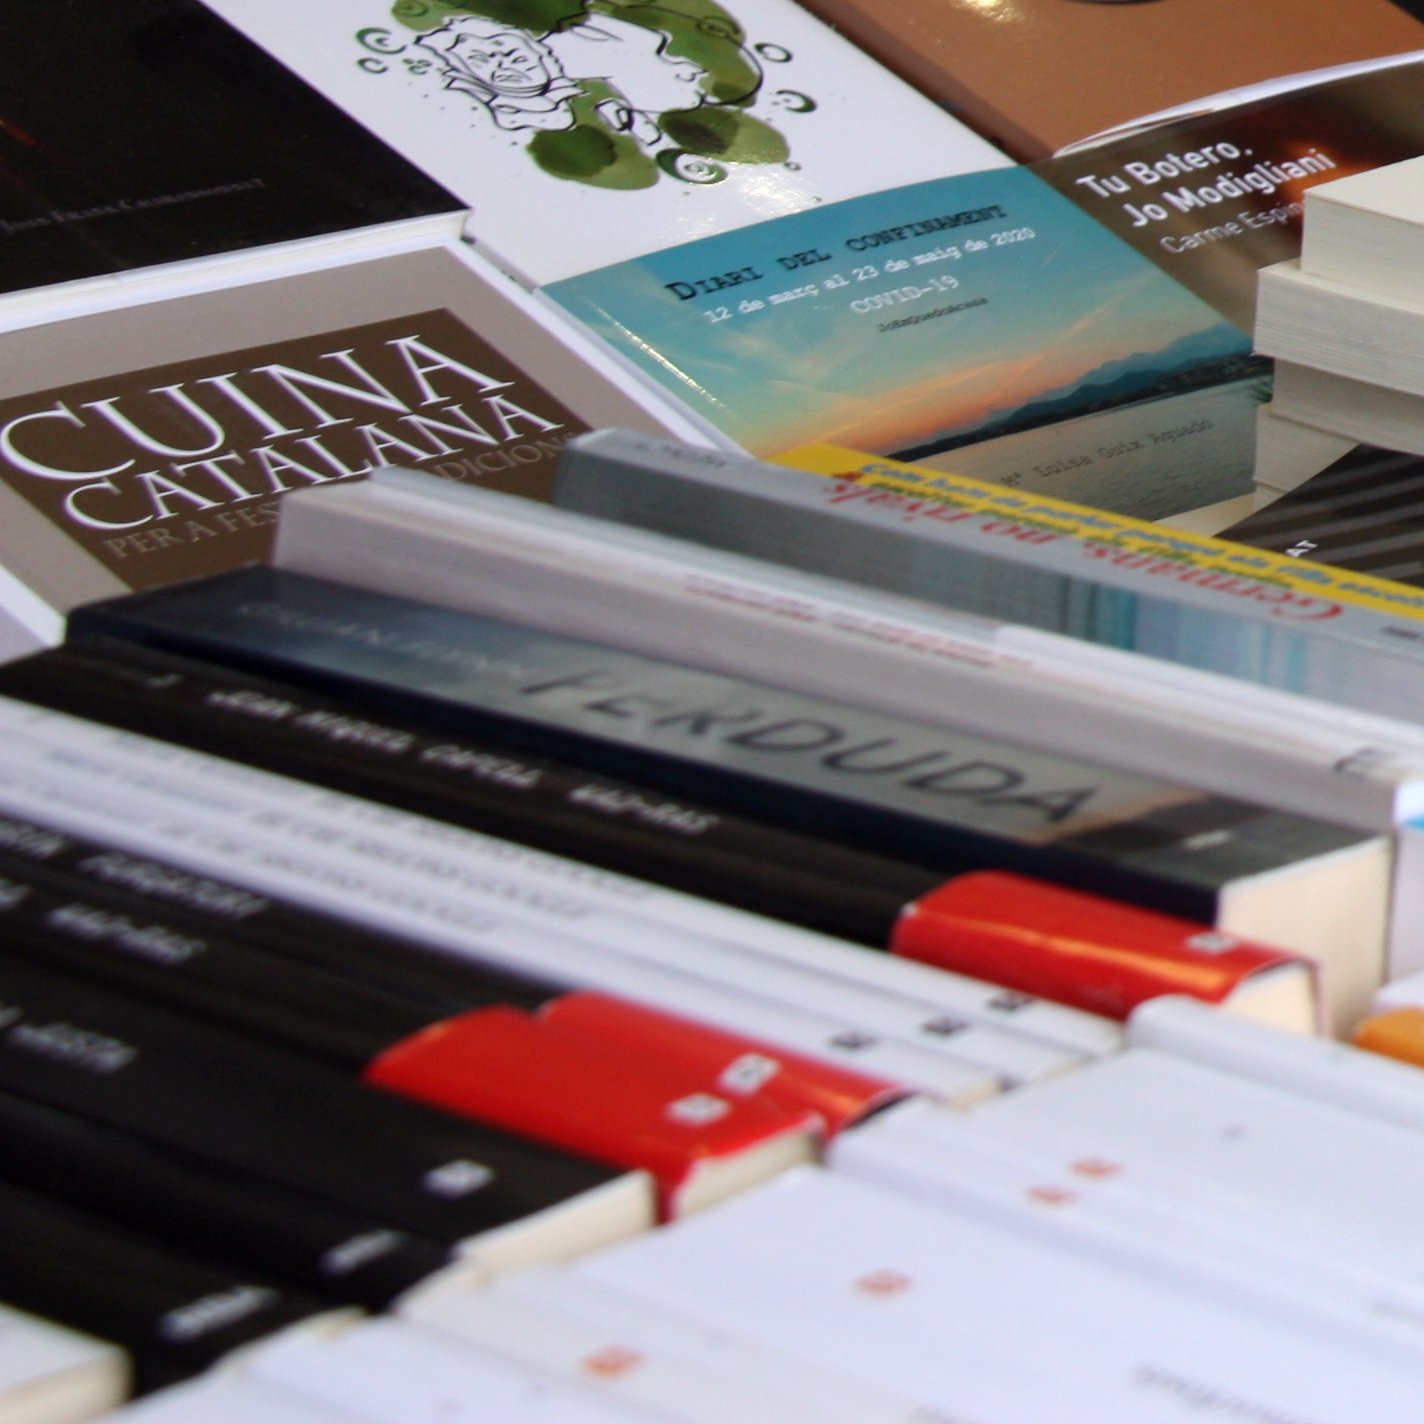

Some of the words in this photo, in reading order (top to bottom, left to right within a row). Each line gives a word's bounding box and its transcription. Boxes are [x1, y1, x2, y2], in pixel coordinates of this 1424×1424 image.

[1076, 174, 1131, 198] Tu
[1124, 140, 1254, 185] Botero.
[1122, 202, 1169, 227] Jo
[1162, 147, 1337, 214] Modigliani
[665, 266, 763, 301] DIARI
[777, 248, 833, 272] DEL
[845, 204, 1008, 253] CONFINAMENT
[704, 306, 734, 324] 12
[738, 297, 765, 315] de
[768, 281, 820, 308] març
[822, 274, 850, 291] al
[852, 265, 880, 284] 23
[884, 255, 910, 274] de
[912, 245, 963, 267] maig
[964, 235, 989, 253] de
[989, 225, 1037, 247] 2020
[1160, 218, 1244, 255] Carme
[849, 274, 960, 315] COVID-19
[0, 334, 515, 481] CUINA
[62, 393, 566, 532] CATALANA
[824, 478, 972, 527] rivals
[103, 527, 179, 562] PER
[187, 516, 217, 544] A
[982, 514, 1060, 548] no
[1081, 539, 1344, 623] Germans,
[520, 659, 1099, 826] PERDUDA
